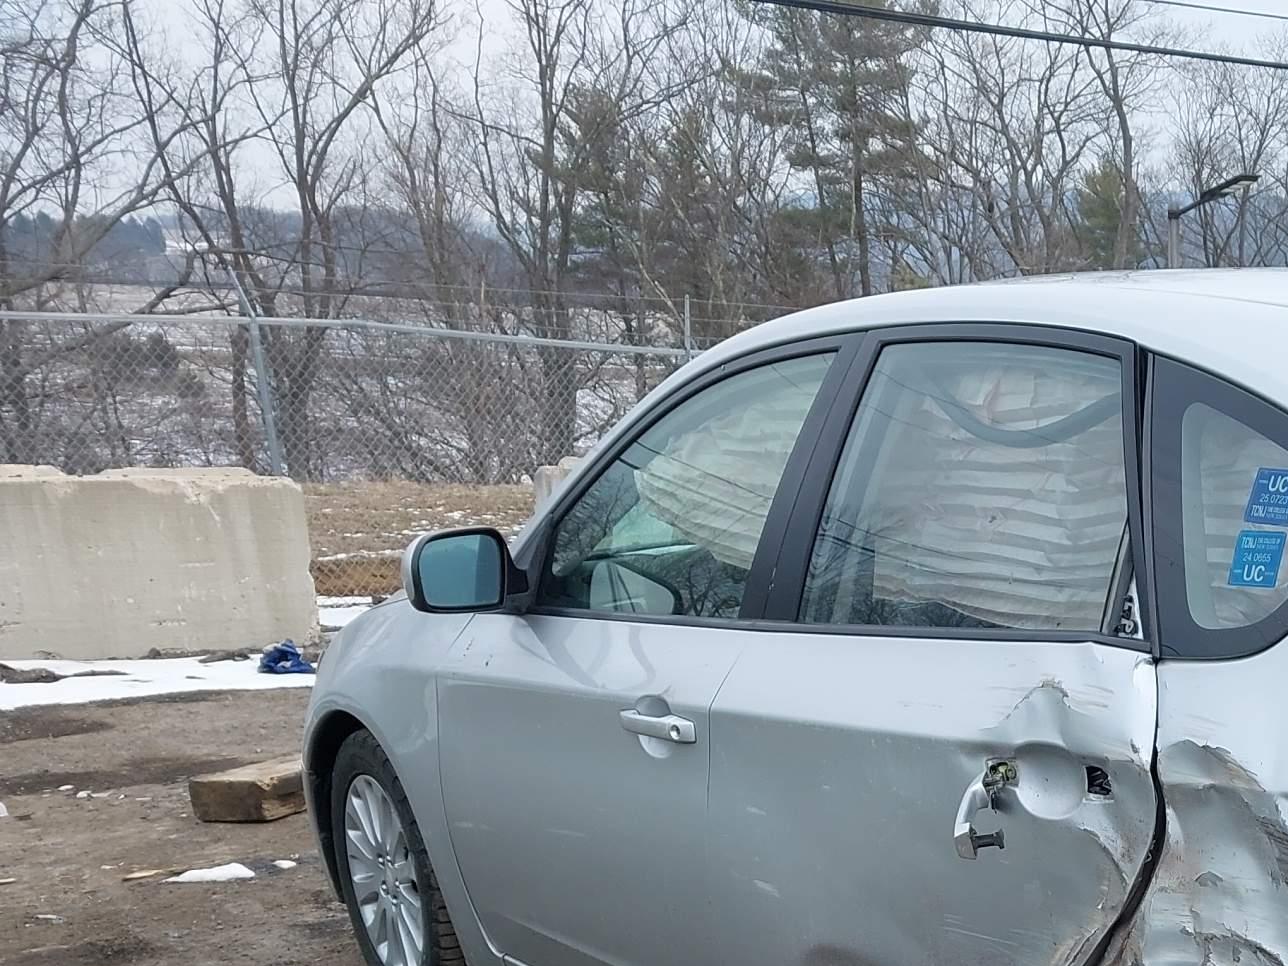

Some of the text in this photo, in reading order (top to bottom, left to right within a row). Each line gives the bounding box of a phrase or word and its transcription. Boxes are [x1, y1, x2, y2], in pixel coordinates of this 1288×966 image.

[1259, 493, 1288, 505] 25 0723
[1251, 505, 1267, 518] TCNJ
[1241, 537, 1257, 549] TCNJ
[1242, 553, 1252, 562] 24
[1243, 565, 1265, 582] UC
